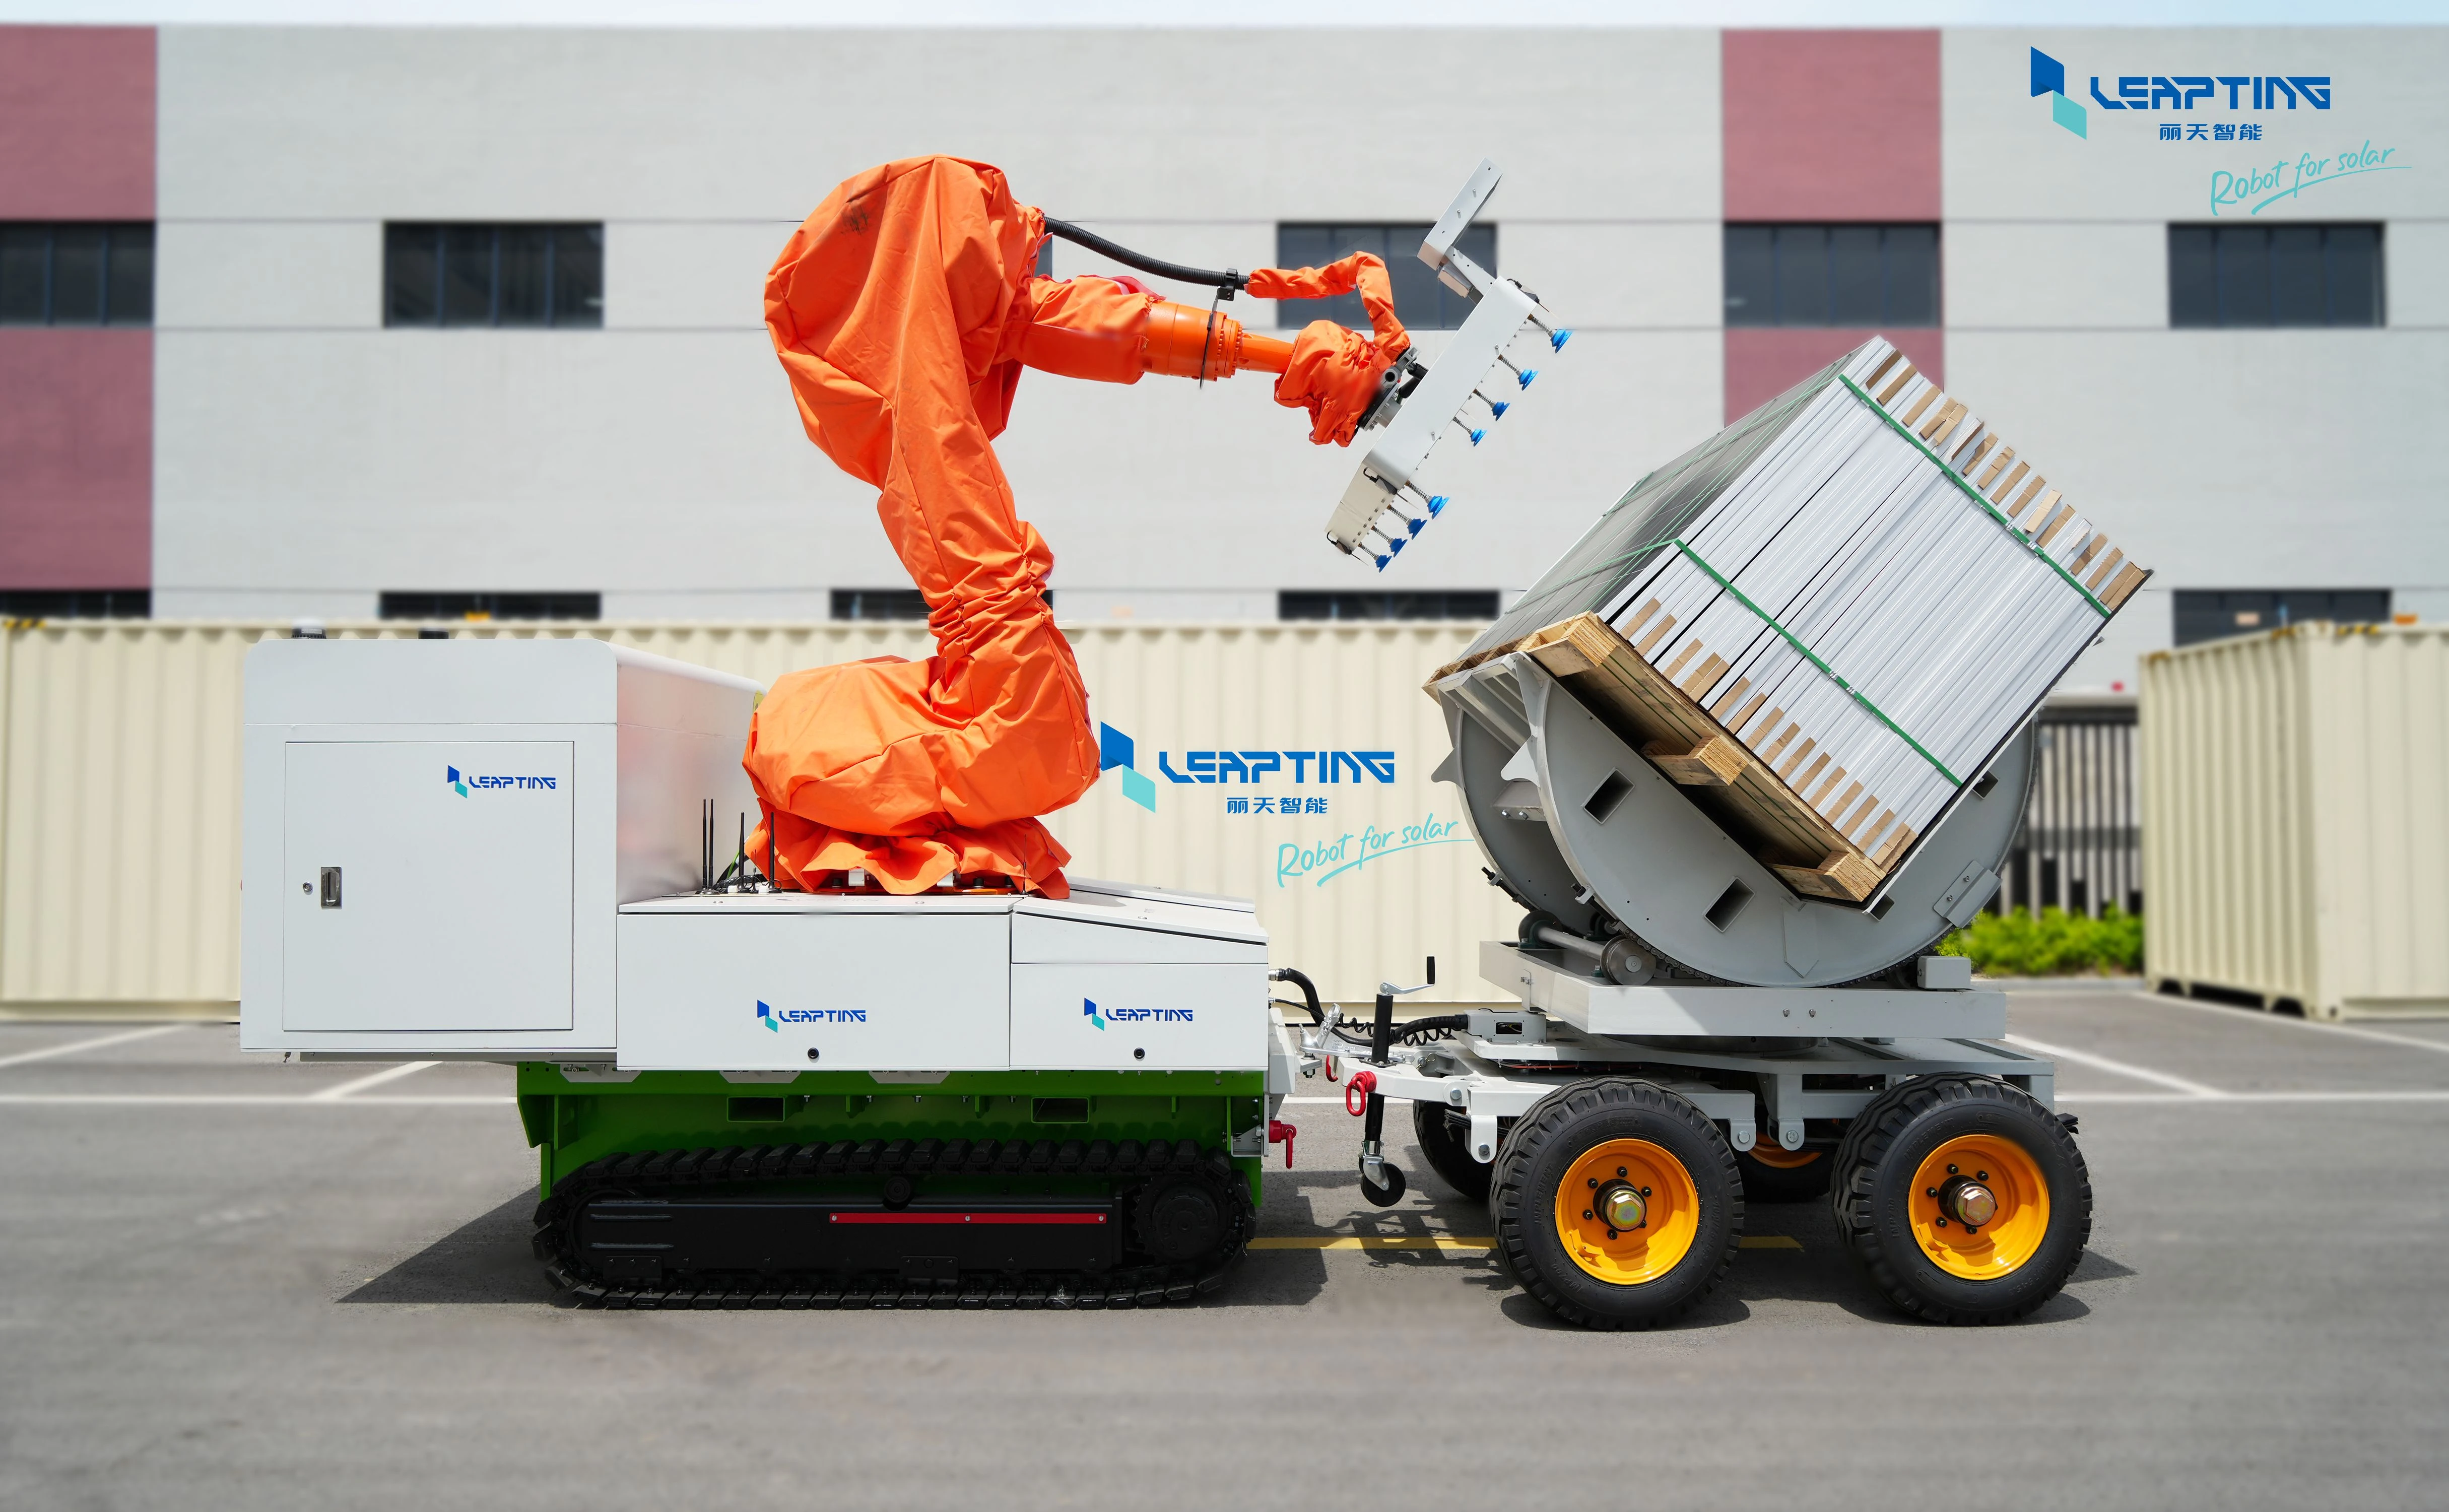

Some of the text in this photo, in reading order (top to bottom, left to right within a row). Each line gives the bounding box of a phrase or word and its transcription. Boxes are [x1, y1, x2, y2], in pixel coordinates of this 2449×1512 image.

[469, 776, 556, 790] LEAPTING
[778, 1009, 867, 1023] LEAPTING
[1105, 1008, 1194, 1022] LEAPTING
[1534, 1162, 1554, 1225] IMPLEMENT
